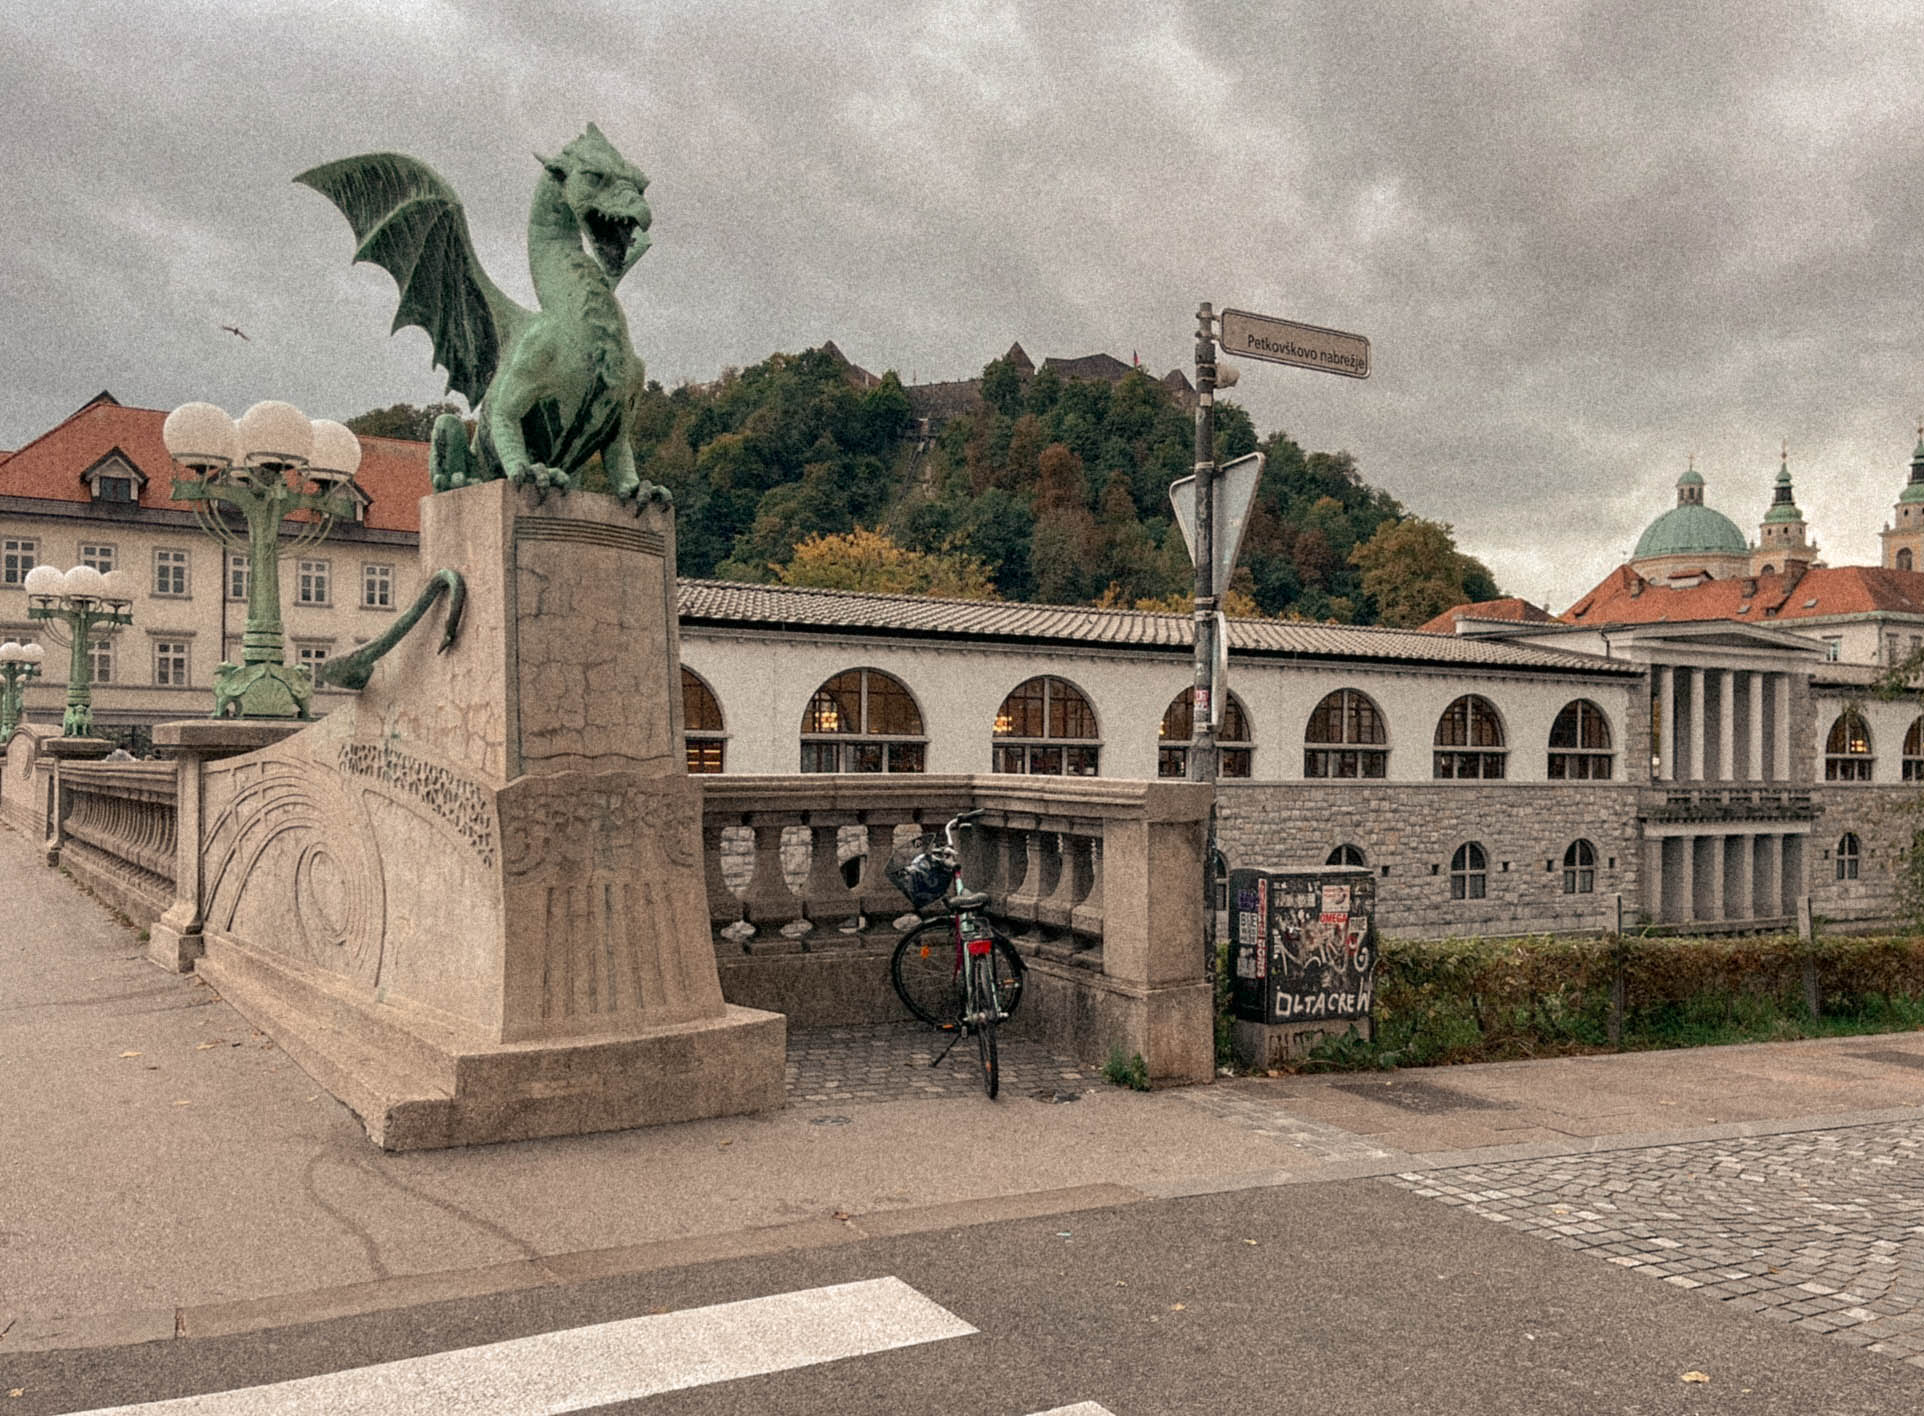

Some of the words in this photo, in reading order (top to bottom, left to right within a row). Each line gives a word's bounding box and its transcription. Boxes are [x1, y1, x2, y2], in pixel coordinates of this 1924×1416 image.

[1248, 334, 1317, 360] Petkovškovo
[1320, 351, 1365, 371] nabrežje
[1320, 912, 1347, 923] OMEGA
